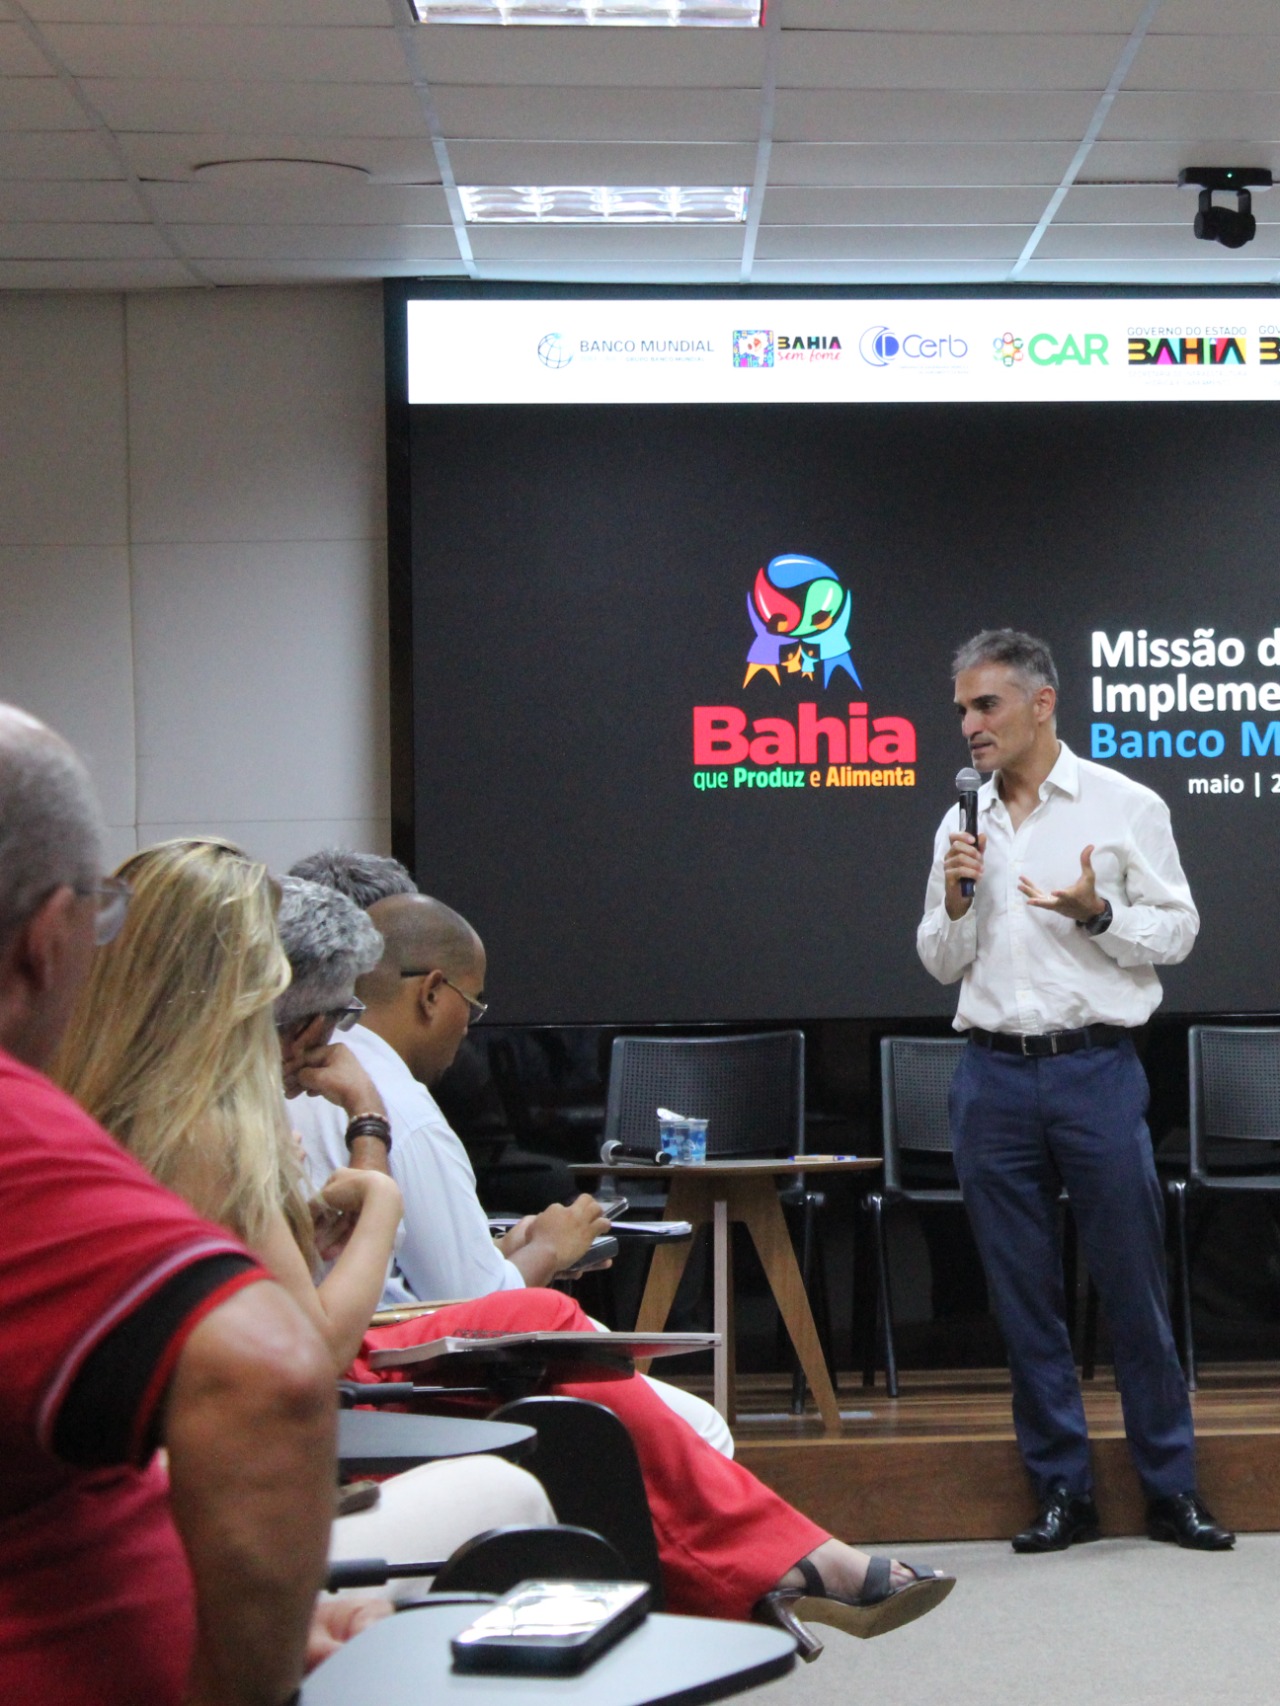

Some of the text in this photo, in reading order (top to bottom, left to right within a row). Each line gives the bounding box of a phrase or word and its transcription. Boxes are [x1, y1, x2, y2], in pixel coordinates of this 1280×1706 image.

[777, 336, 842, 350] BAHIA
[1127, 326, 1247, 336] GOVERNO DO ESTADO
[580, 340, 714, 353] BANCO MUNDIAL
[777, 349, 842, 363] sem fome
[902, 334, 969, 359] Cerb
[1028, 333, 1110, 366] CAR
[1128, 337, 1247, 365] BAHIA
[1091, 629, 1246, 668] Missão
[693, 701, 917, 765] Bahia
[1090, 722, 1226, 759] Banco
[693, 765, 916, 791] que Produz e Alimenta
[1188, 774, 1245, 794] maio
